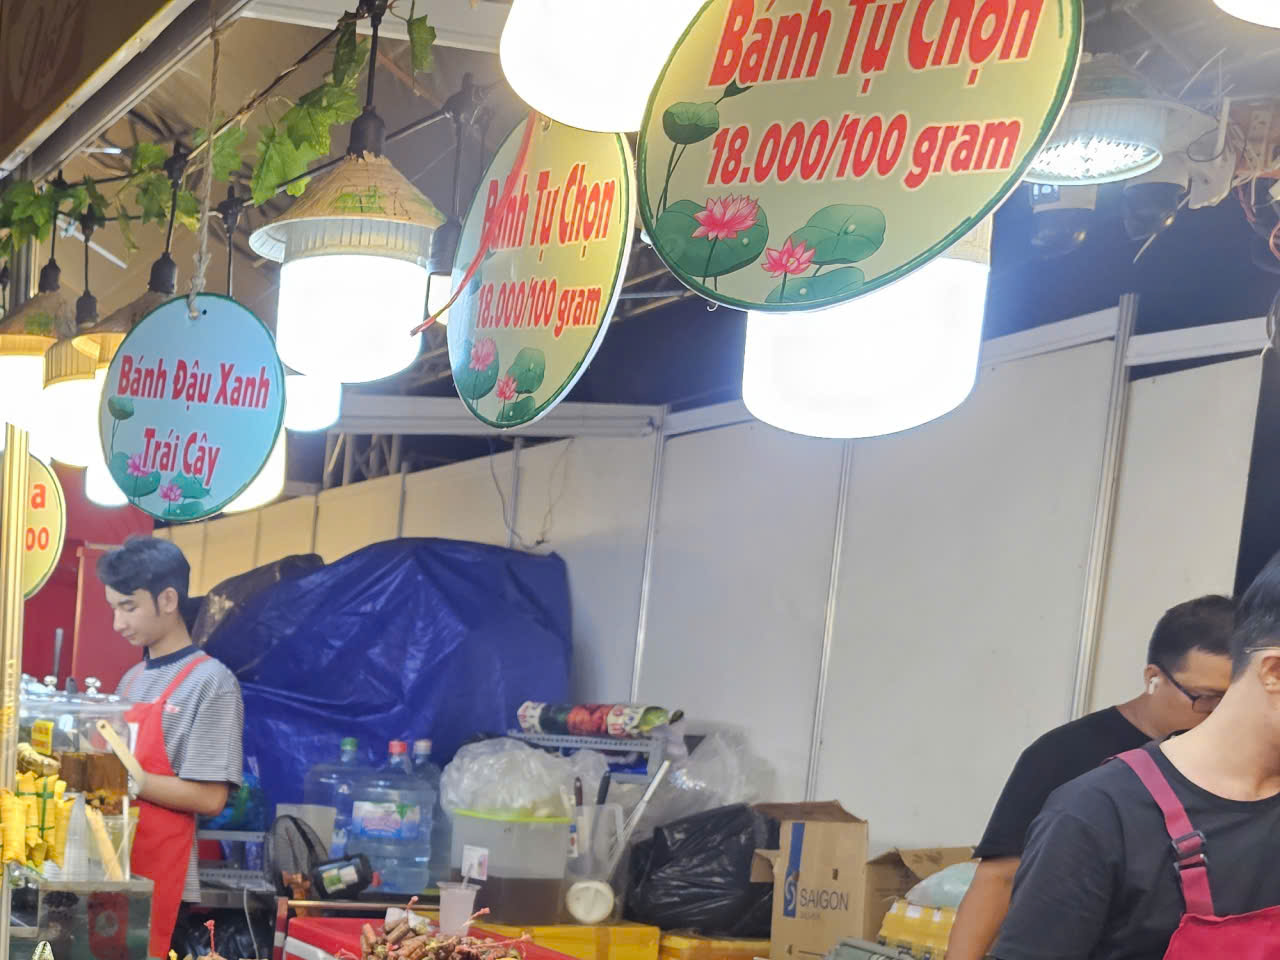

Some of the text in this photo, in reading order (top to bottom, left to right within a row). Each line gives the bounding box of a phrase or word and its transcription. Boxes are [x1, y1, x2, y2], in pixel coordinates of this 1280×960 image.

[907, 0, 1045, 86] Chọn
[707, 113, 1022, 189] 18.000/100 gram
[558, 163, 616, 259] Chọn
[476, 276, 602, 338] 18.000/100 gram
[117, 354, 271, 411] Bánh Đậu Xanh
[141, 427, 221, 487] Trái Cây
[799, 887, 849, 911] SAIGON
